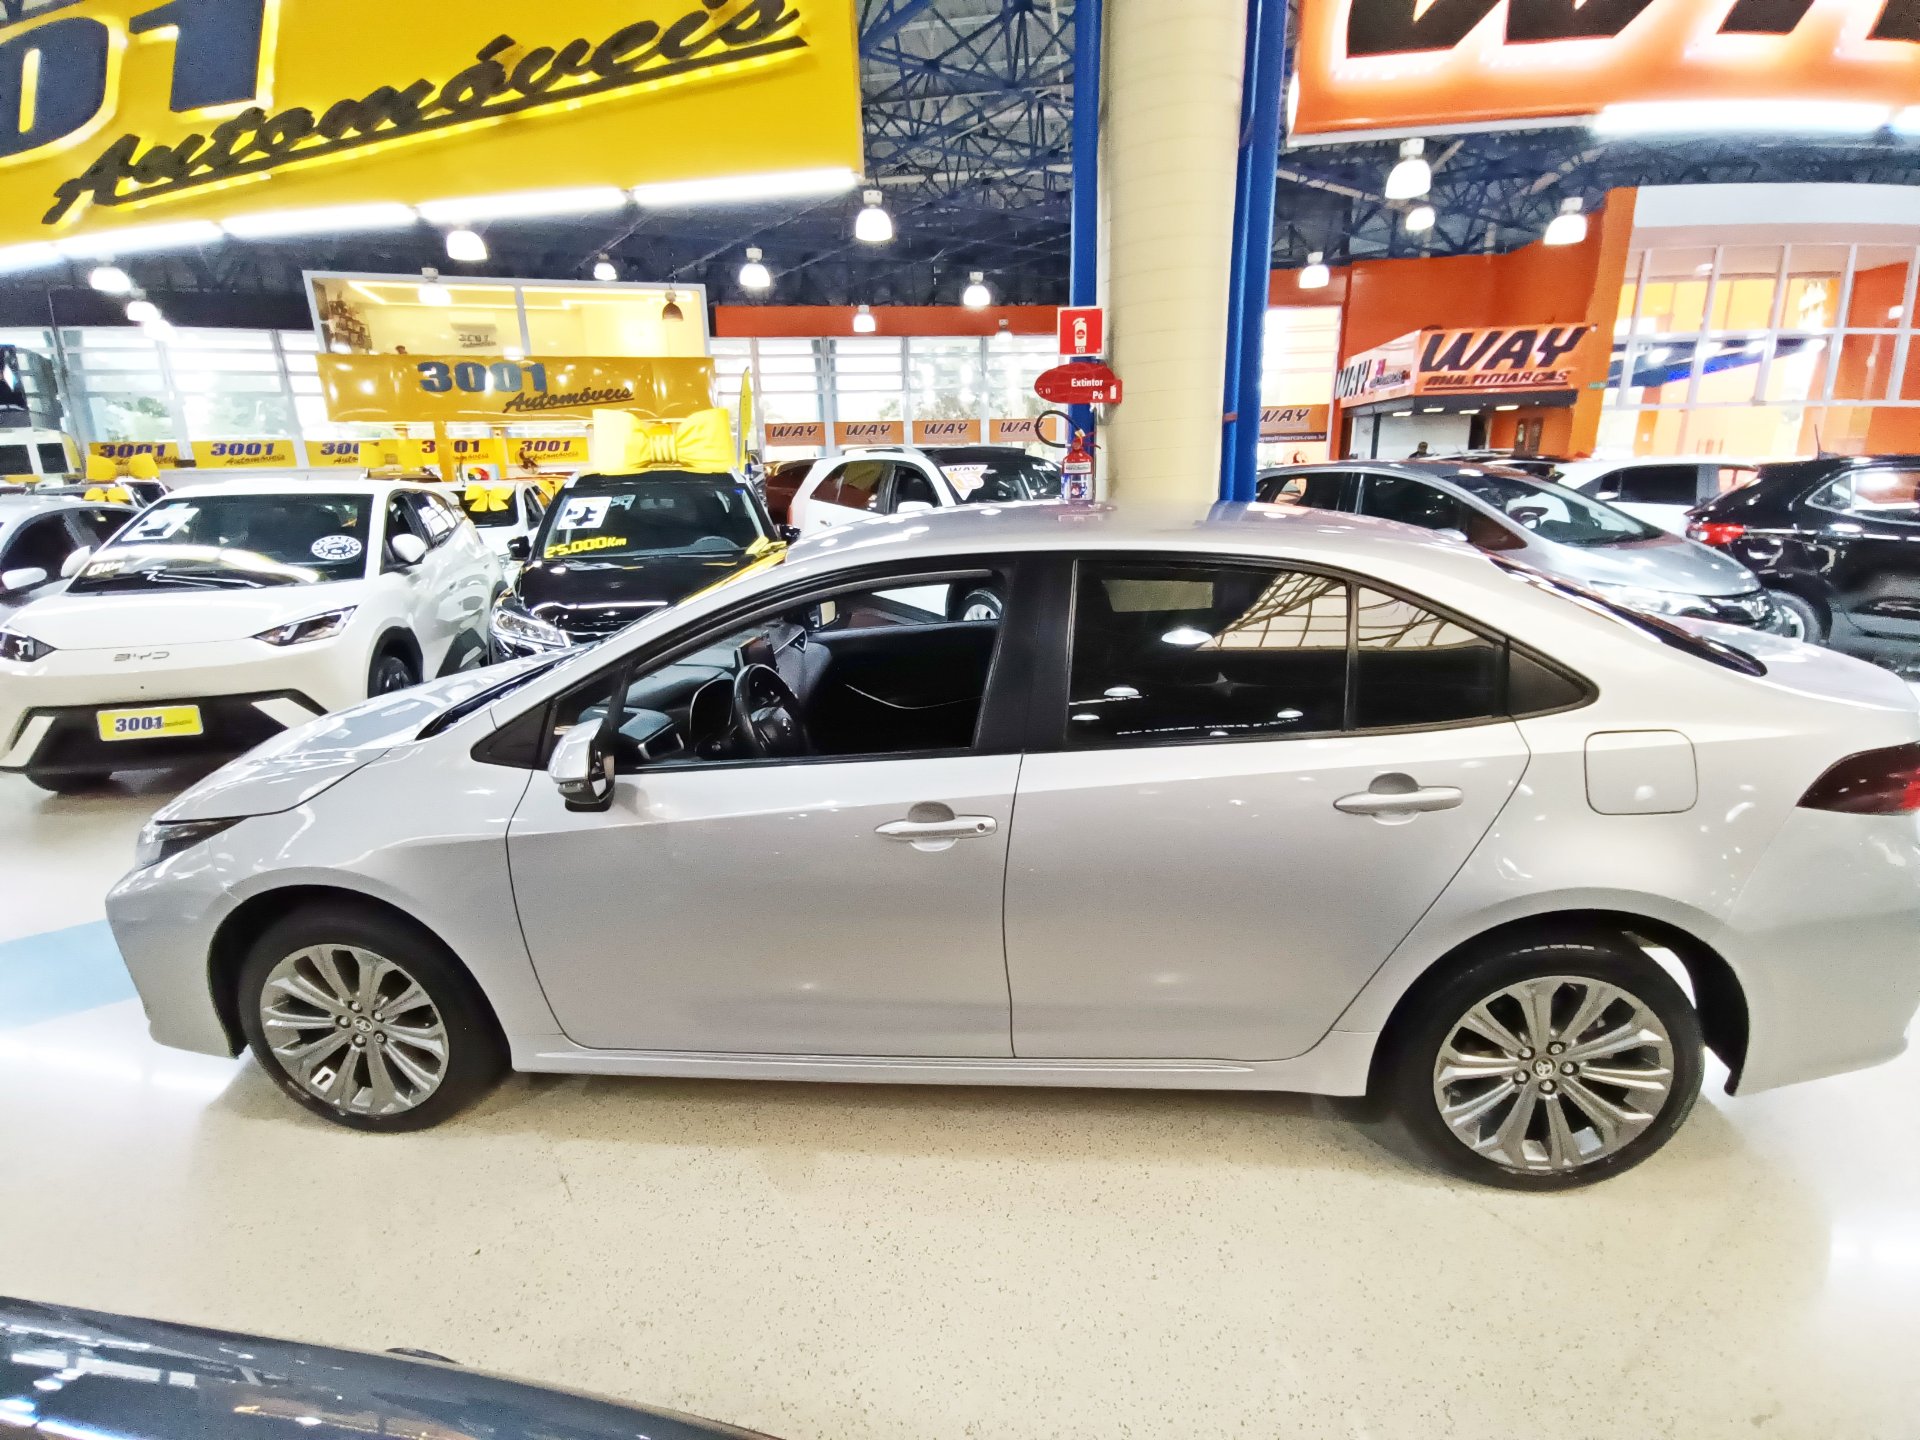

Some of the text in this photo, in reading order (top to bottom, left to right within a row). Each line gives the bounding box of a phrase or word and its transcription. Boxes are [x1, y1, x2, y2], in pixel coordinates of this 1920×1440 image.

[42, 0, 802, 224] Automóveis
[1420, 327, 1588, 372] WAY
[418, 361, 547, 392] 3001
[1071, 378, 1103, 387] Extintor
[502, 386, 633, 413] Automóveis
[1092, 390, 1104, 400] Pó
[772, 425, 818, 437] WAY
[846, 424, 891, 435] WAY
[924, 423, 968, 435] WAY
[210, 442, 275, 456] 3001
[421, 440, 480, 453] 301
[521, 440, 571, 452] 3001
[115, 716, 163, 732] 3001
